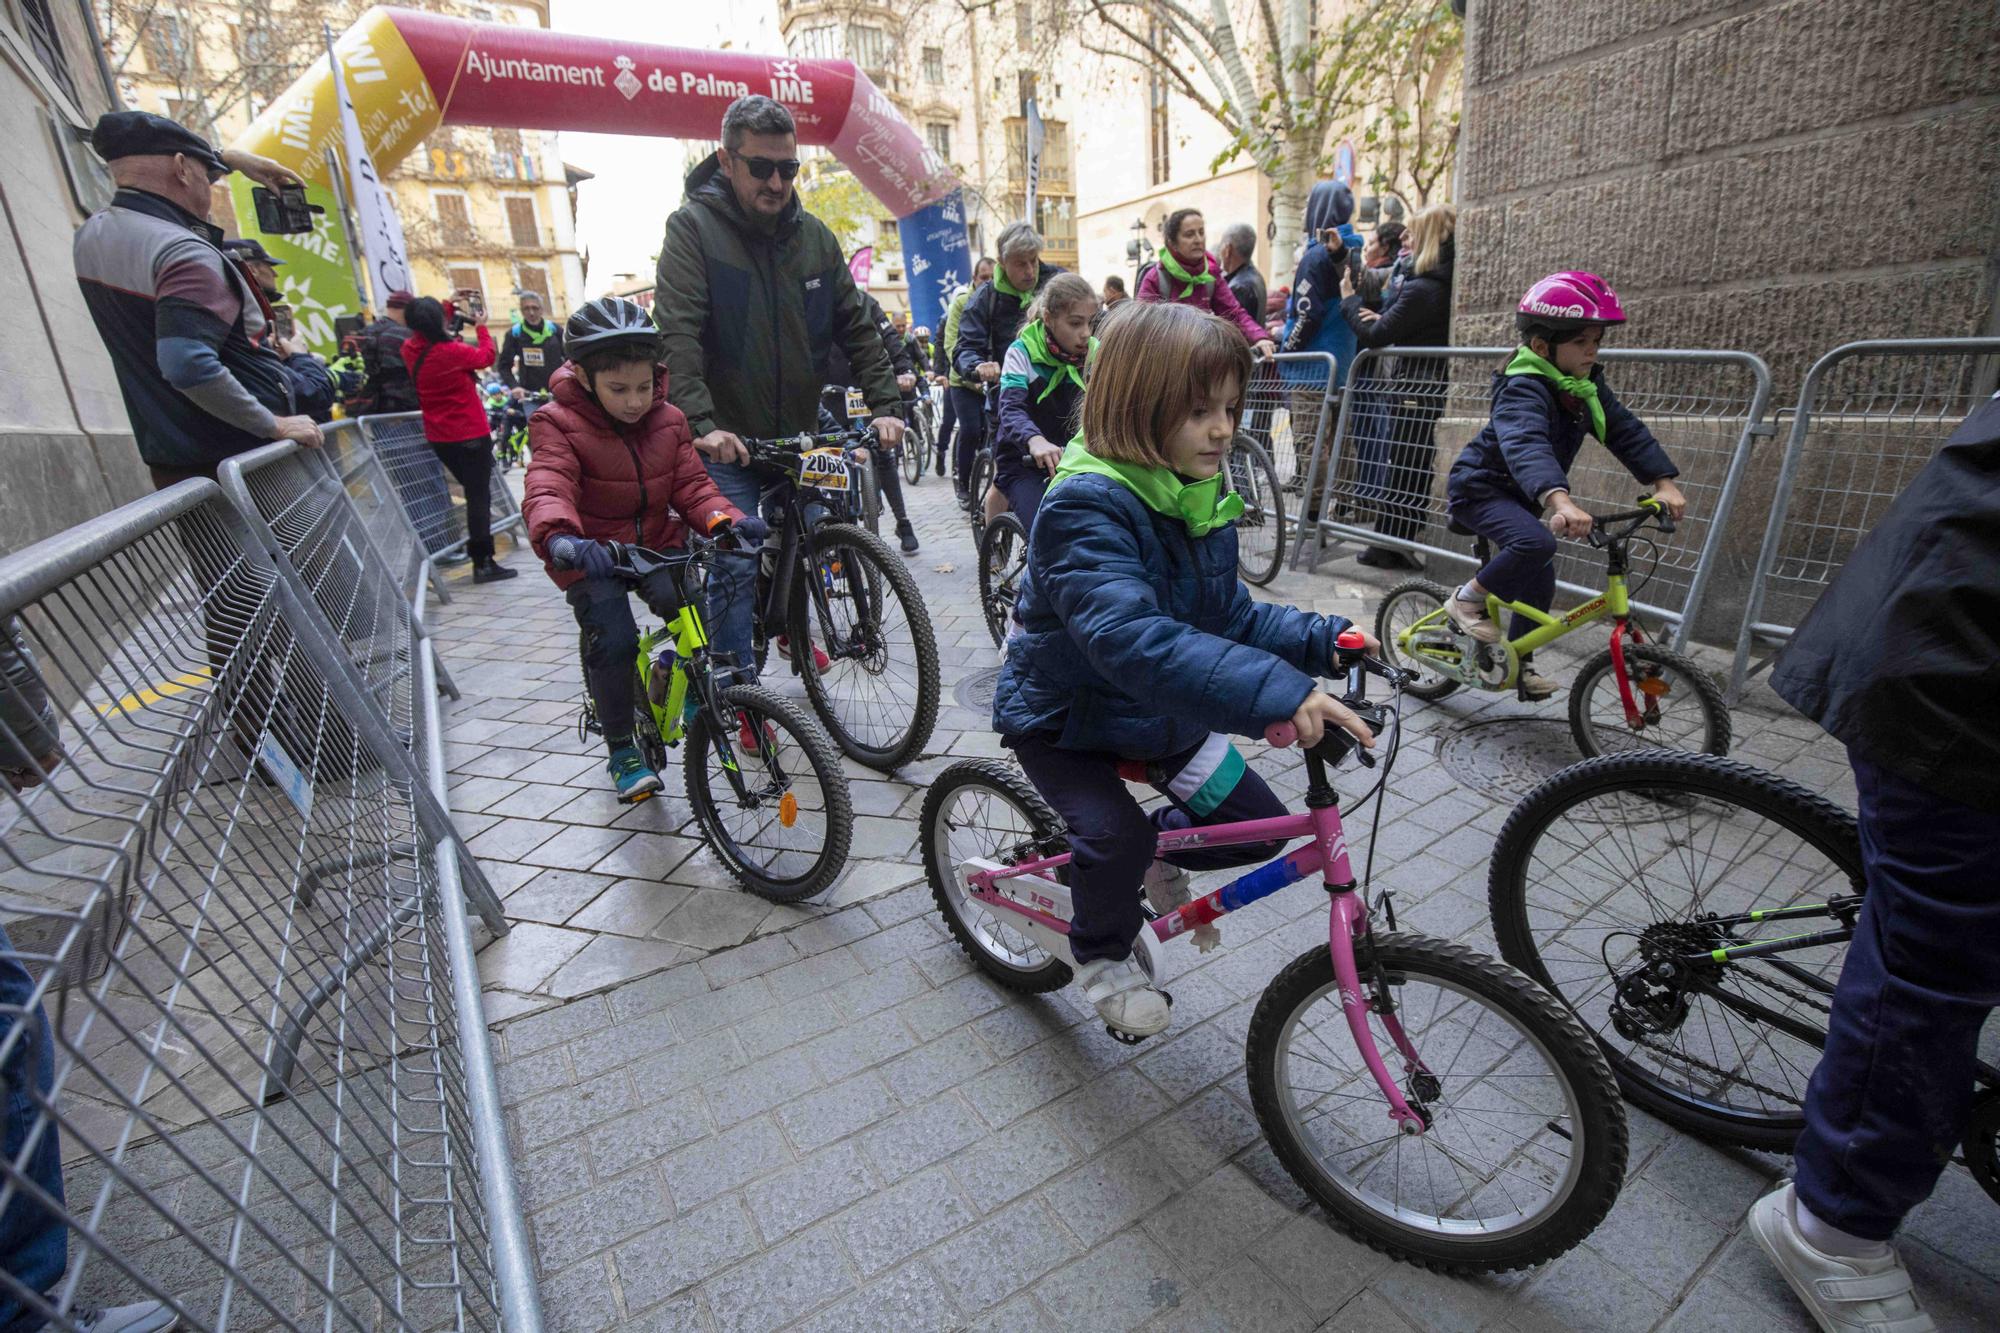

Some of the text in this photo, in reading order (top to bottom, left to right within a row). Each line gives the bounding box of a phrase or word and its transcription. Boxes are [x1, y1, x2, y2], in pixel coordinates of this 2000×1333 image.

[466, 50, 749, 98] Ajuntament de Palma
[770, 78, 814, 104] IME
[942, 210, 960, 223] IME
